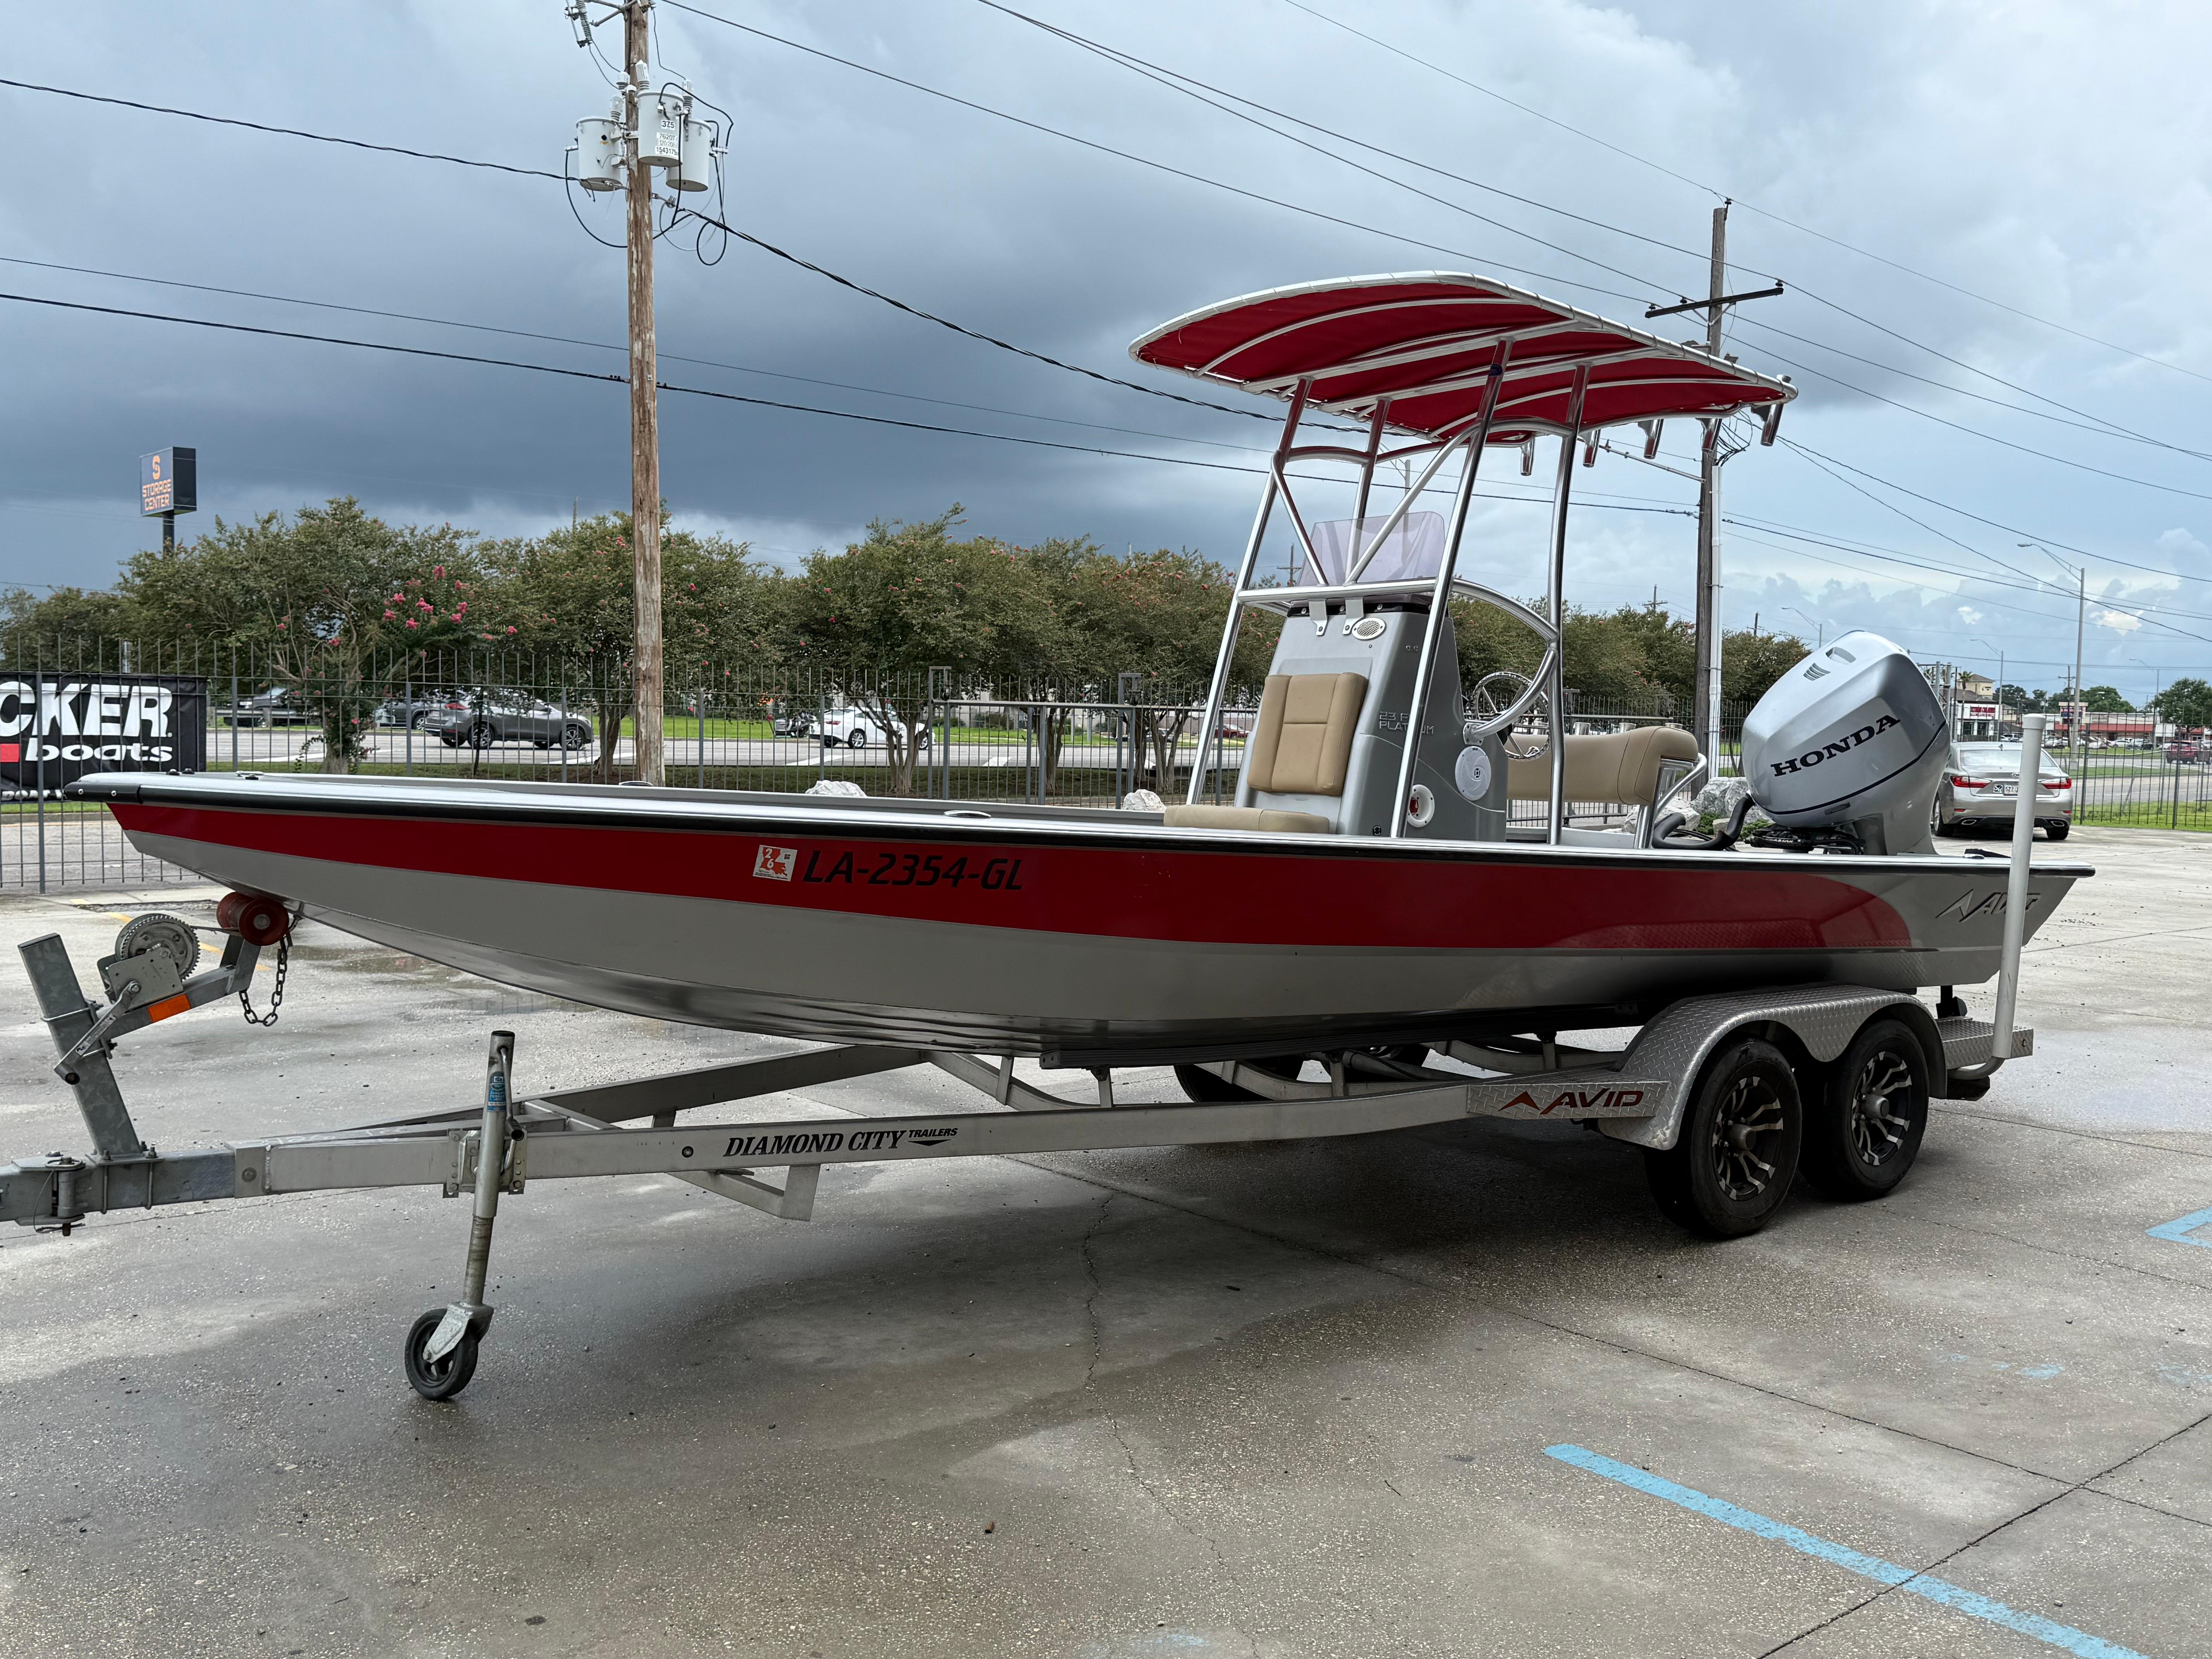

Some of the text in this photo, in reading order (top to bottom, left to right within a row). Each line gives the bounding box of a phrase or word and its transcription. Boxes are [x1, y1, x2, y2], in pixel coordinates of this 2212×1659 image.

[152, 455, 161, 480] S
[142, 479, 172, 497] STORAGE
[144, 493, 170, 511] CENTER
[1379, 720, 1434, 735] PLATUM
[1400, 713, 1410, 721] F
[25, 737, 173, 762] boats
[1770, 714, 1901, 777] HONDA
[803, 850, 1023, 891] LA-2354-GL
[1540, 1088, 1644, 1115] AVID
[723, 1127, 958, 1157] DIAMOND CITY TRAILERS
